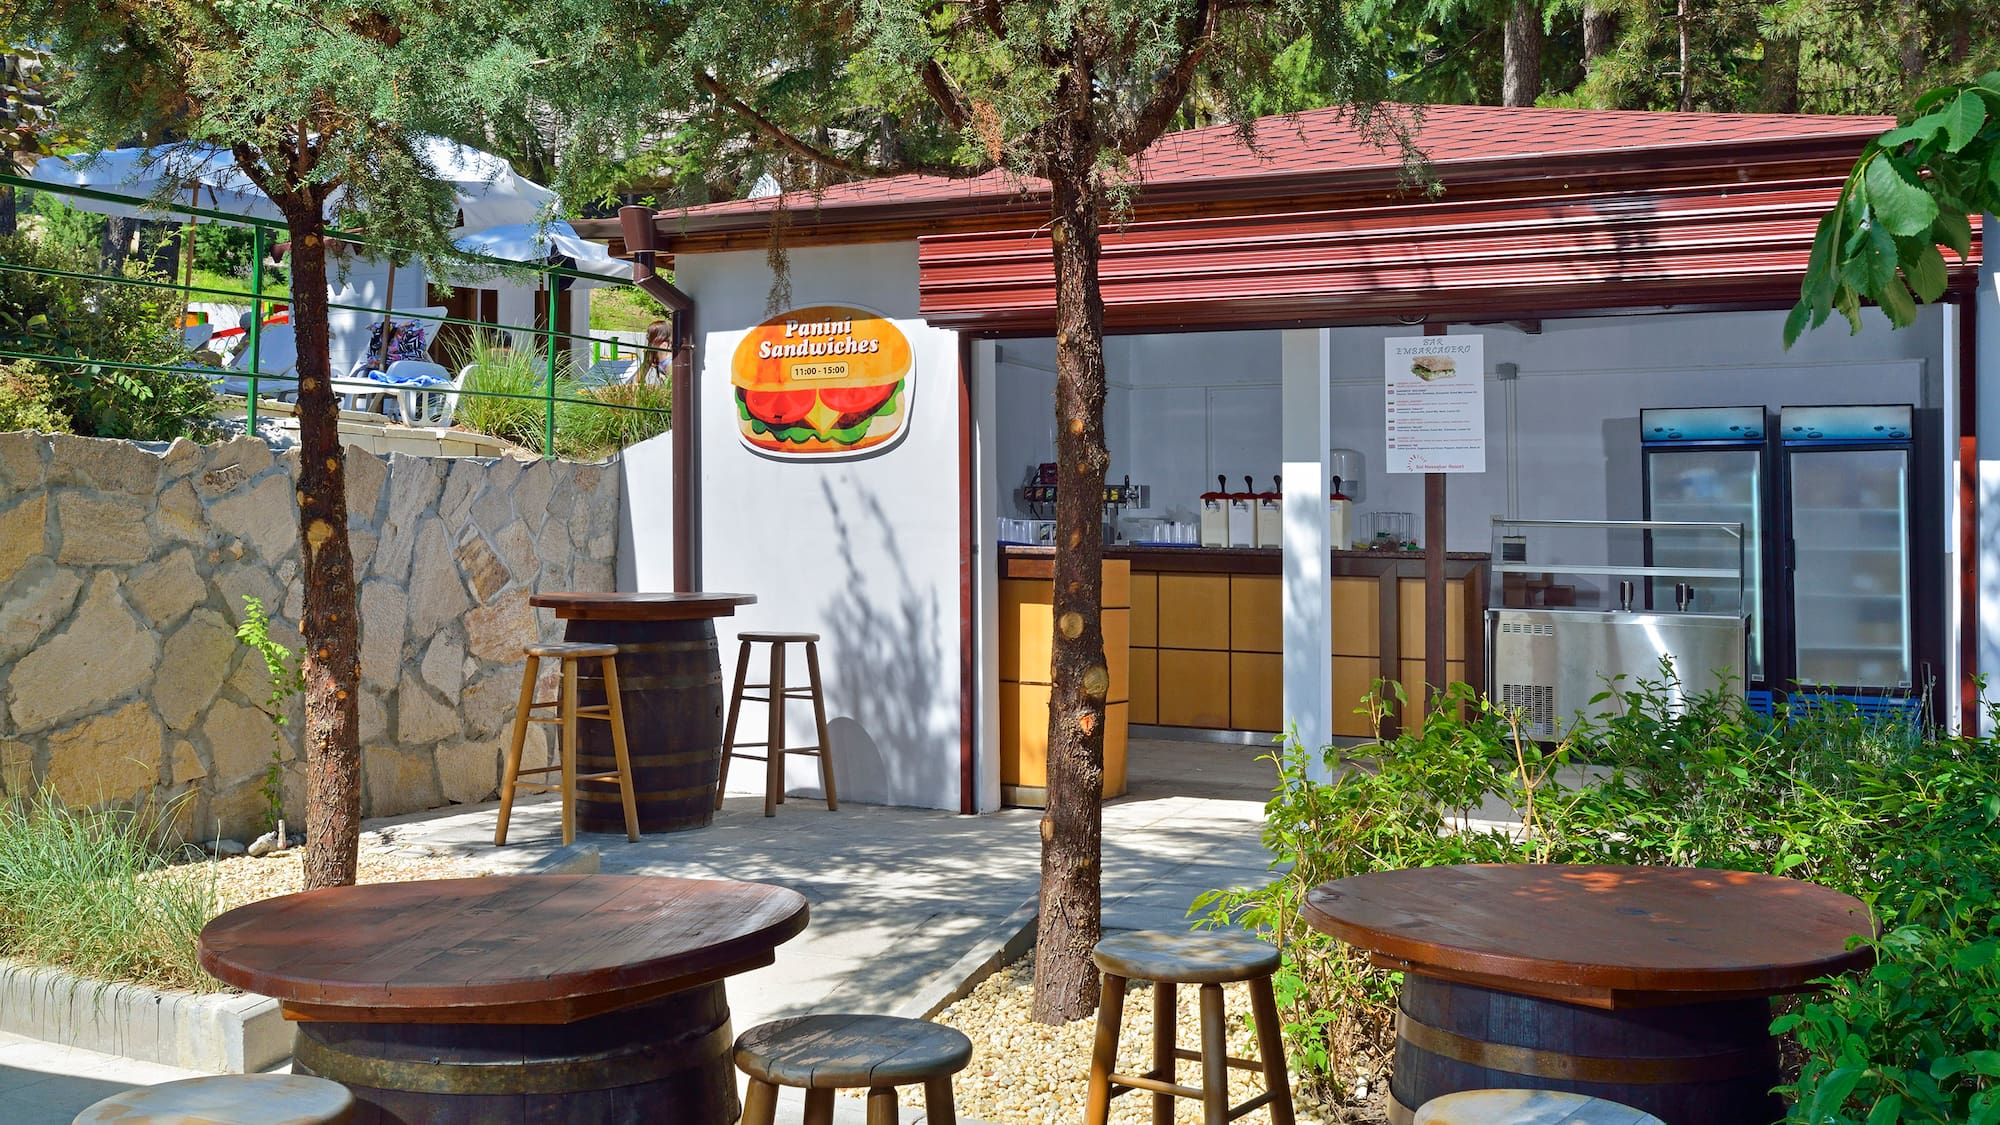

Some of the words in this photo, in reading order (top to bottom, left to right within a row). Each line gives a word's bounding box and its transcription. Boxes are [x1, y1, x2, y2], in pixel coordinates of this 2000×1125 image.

[785, 317, 851, 337] Panini
[1423, 338, 1444, 346] BAR
[759, 337, 879, 358] Sandwiches
[1397, 345, 1471, 355] EMBARCADERO
[795, 368, 816, 376] 11:00
[823, 366, 845, 375] 15:00
